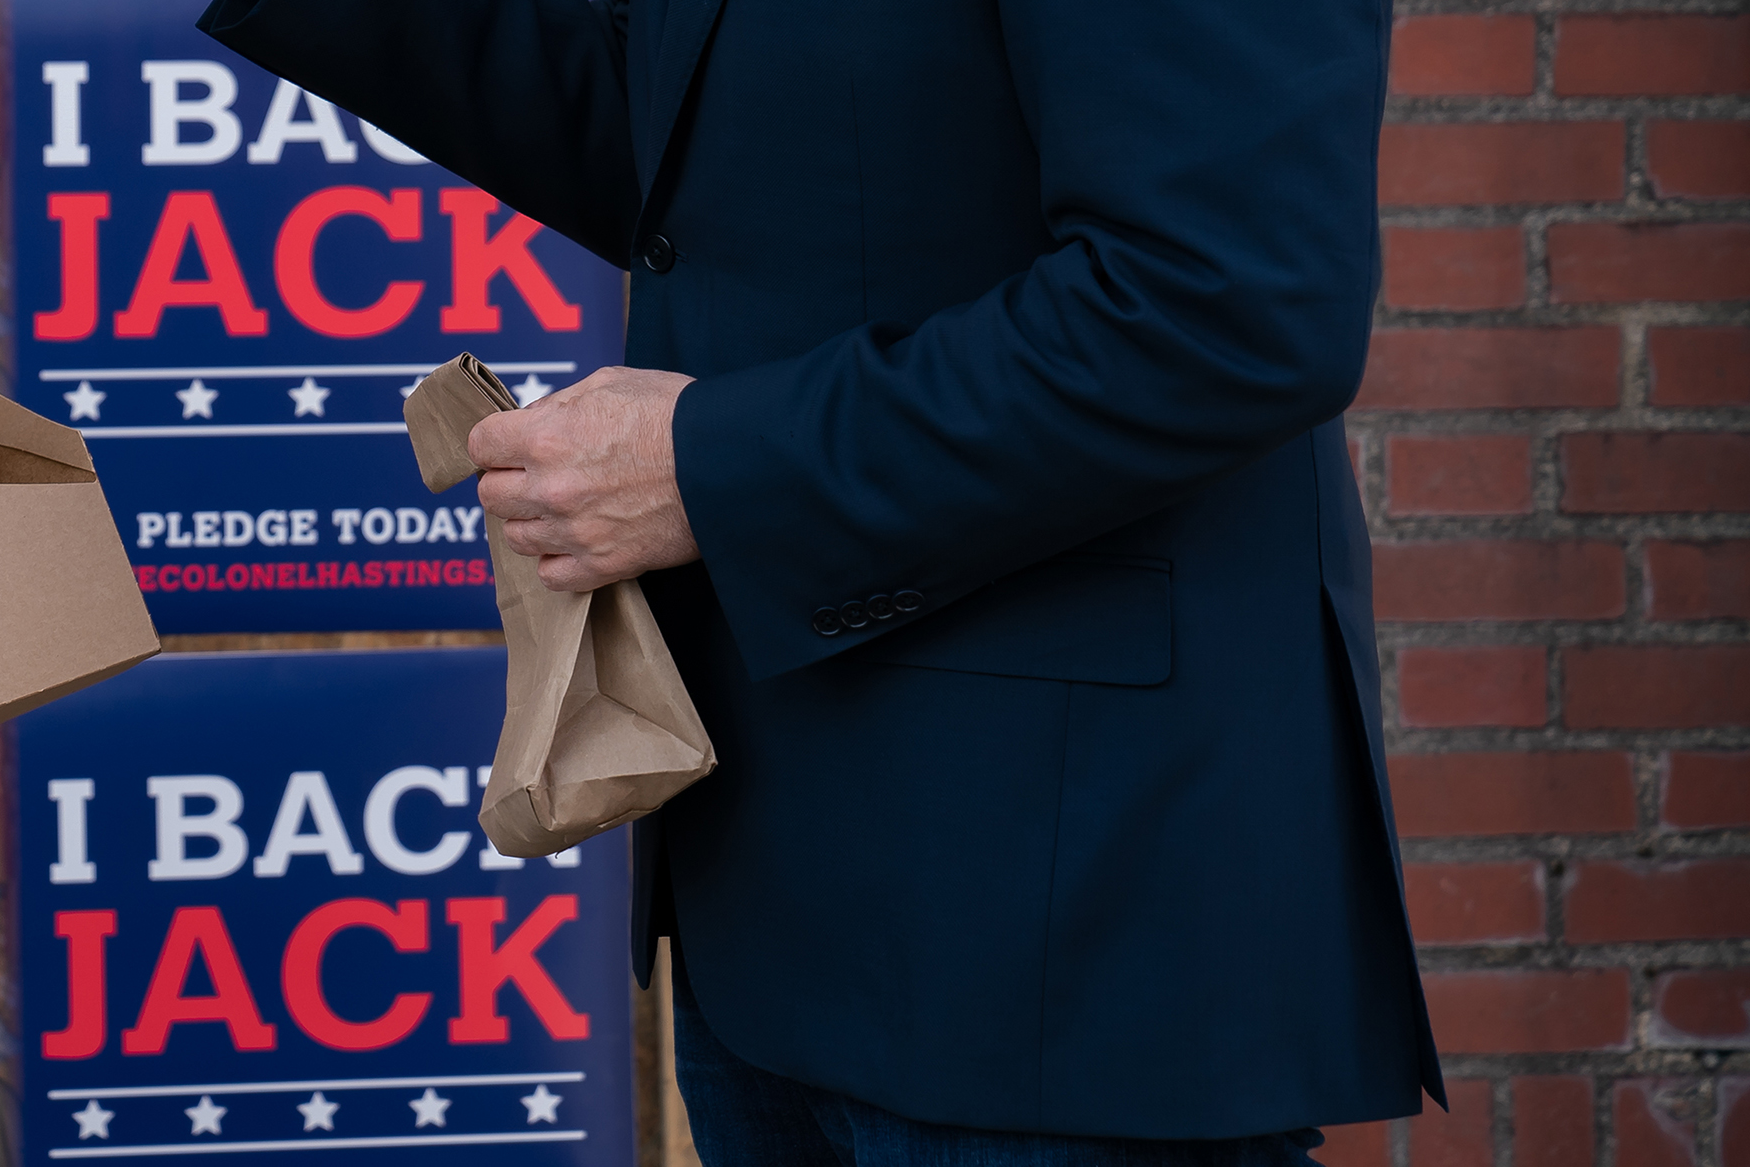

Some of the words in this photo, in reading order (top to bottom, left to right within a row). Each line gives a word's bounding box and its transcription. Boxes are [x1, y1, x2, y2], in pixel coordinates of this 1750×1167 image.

[41, 61, 90, 168] I
[140, 59, 432, 166] BA
[34, 185, 583, 341] JACK
[136, 510, 318, 547] PLEDGE
[332, 506, 487, 545] TODAY
[48, 778, 96, 884] I
[41, 894, 591, 1061] JACK
